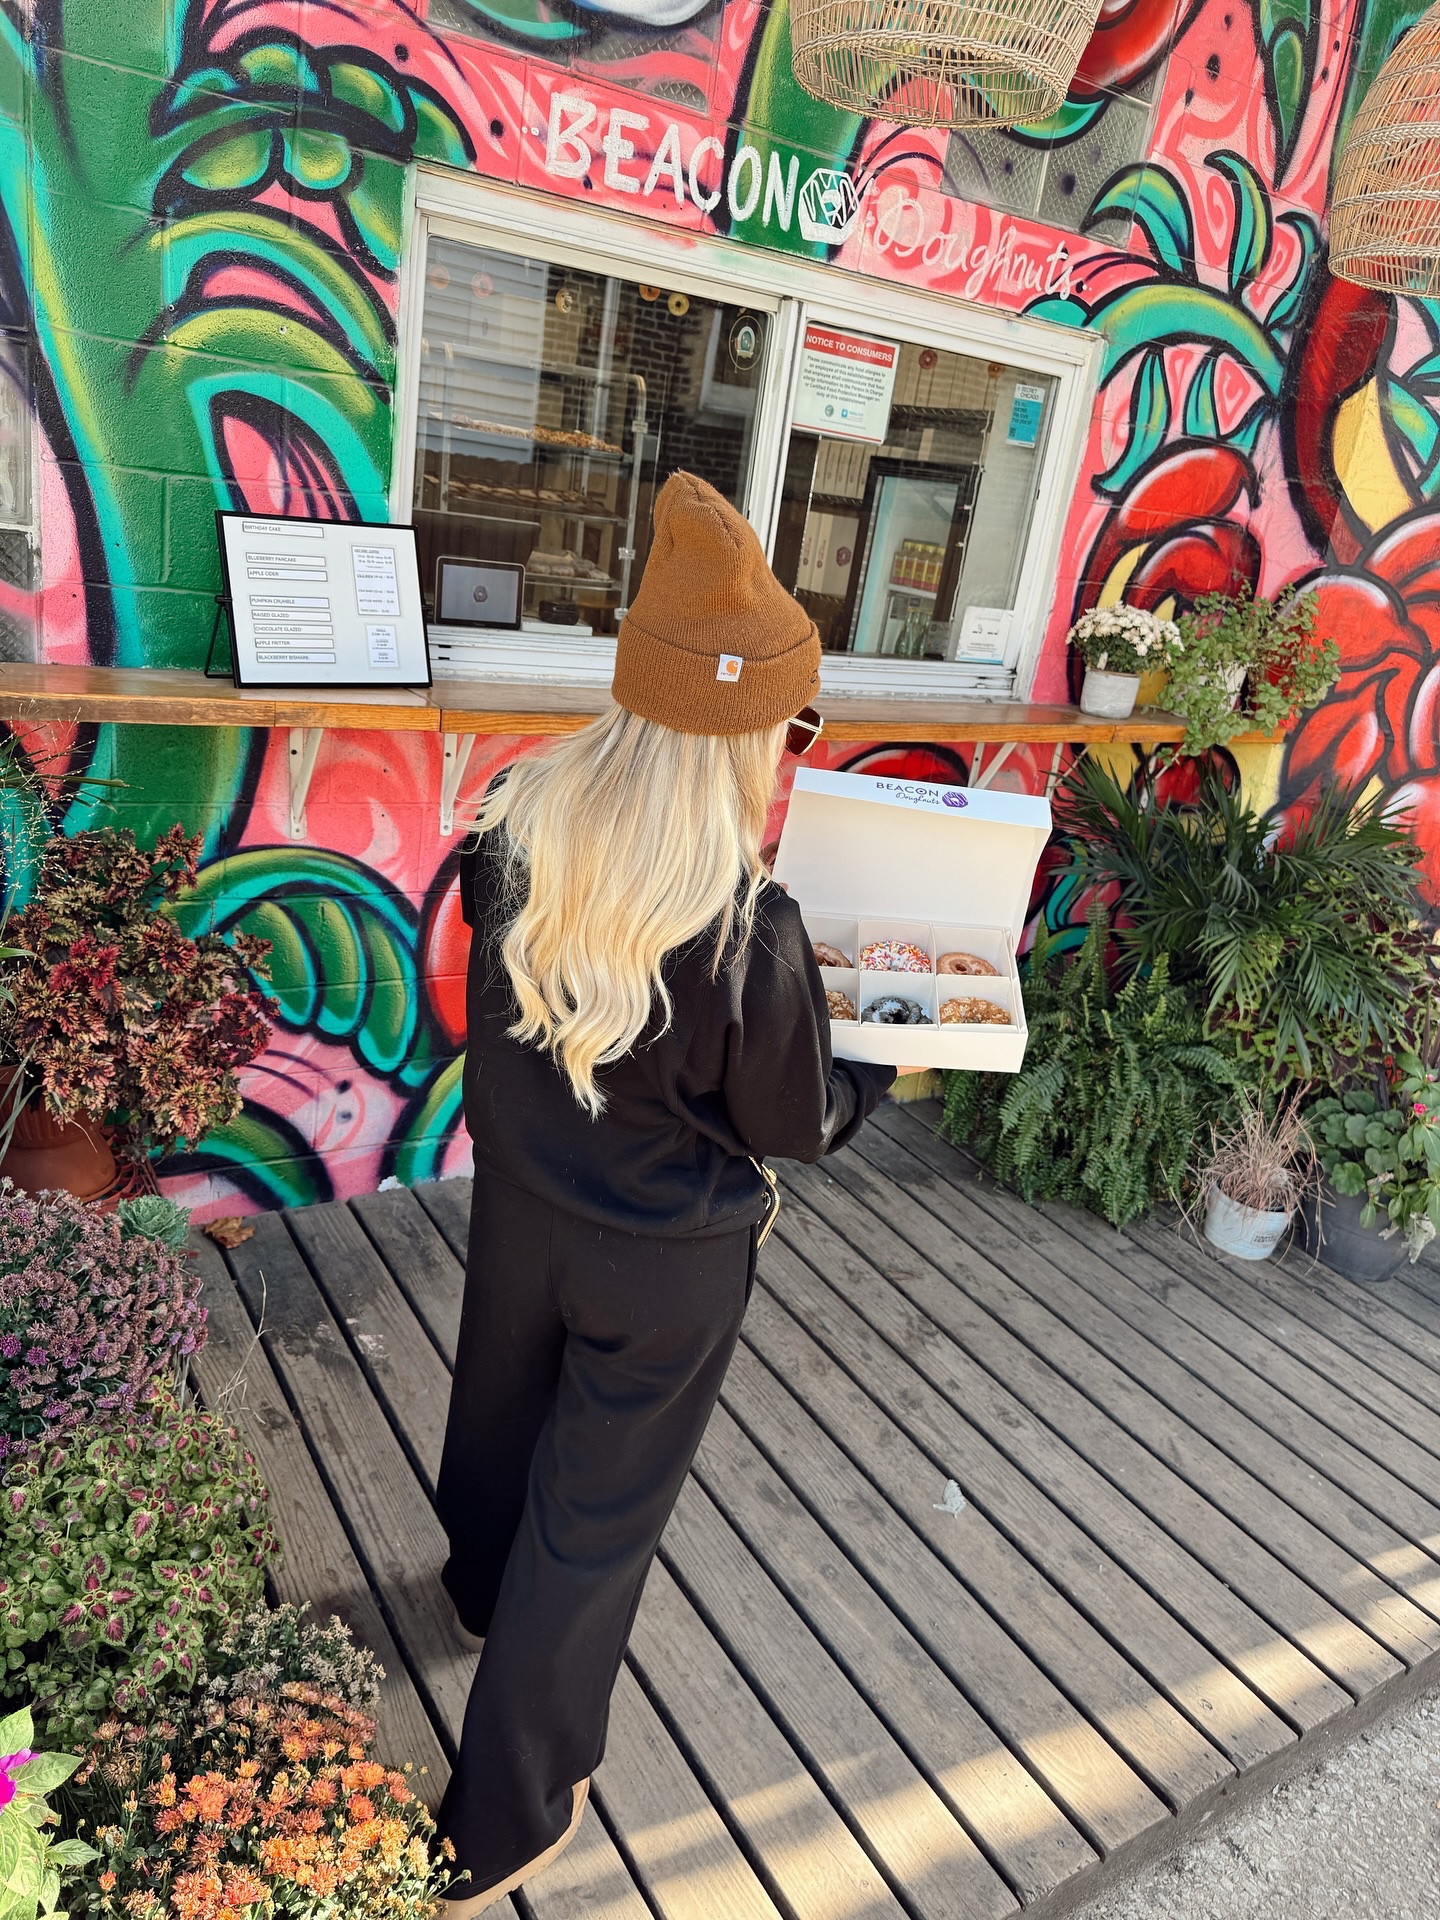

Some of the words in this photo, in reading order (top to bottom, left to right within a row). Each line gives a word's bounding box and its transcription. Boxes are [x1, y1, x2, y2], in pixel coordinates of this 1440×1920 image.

[546, 91, 800, 232] BEACON
[873, 188, 1075, 299] Doughnuts
[806, 334, 834, 348] NOTICE
[835, 341, 845, 351] TO
[846, 344, 893, 362] CONSUMERS
[821, 358, 846, 369] communicate
[244, 524, 267, 532] BIRTHDAY
[876, 782, 939, 797] BEACON
[896, 792, 940, 805] Doughnuts
